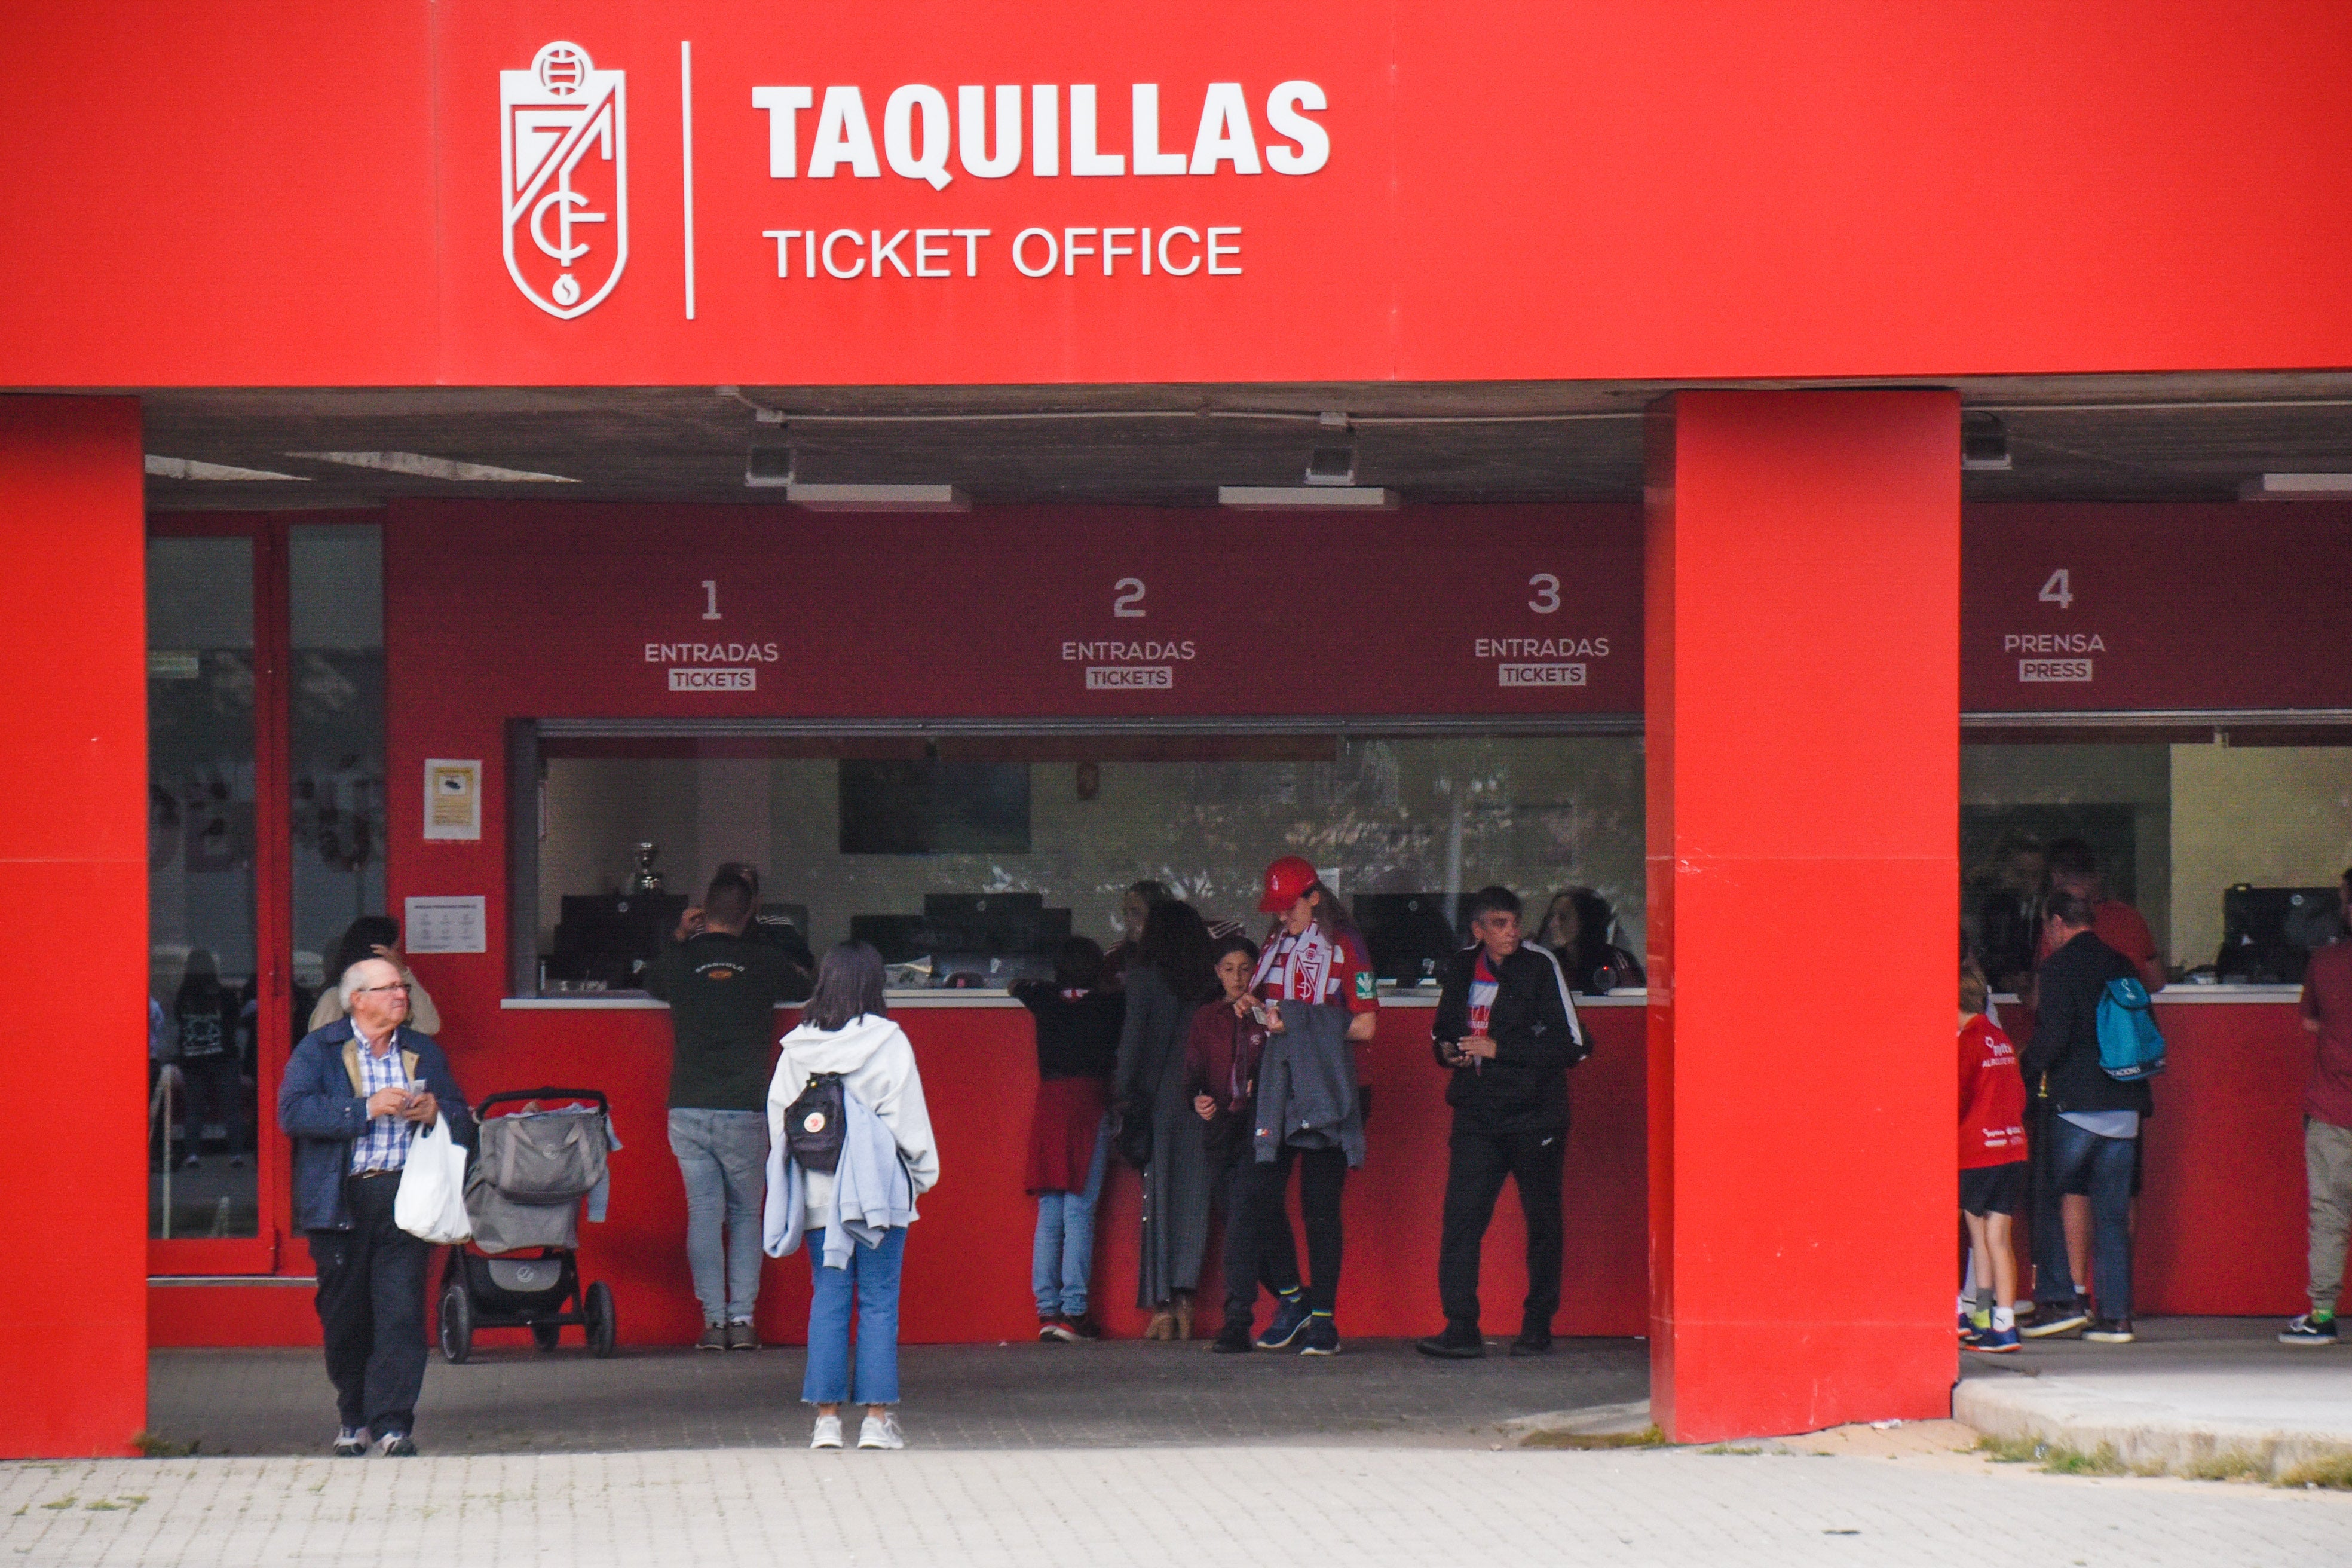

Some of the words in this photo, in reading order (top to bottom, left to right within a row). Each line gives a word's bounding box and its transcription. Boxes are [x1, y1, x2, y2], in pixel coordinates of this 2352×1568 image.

[751, 79, 1331, 191] TAQUILLAS
[762, 228, 991, 279] TICKET
[1012, 225, 1242, 278] OFFICE
[1113, 577, 1147, 618] 2
[1527, 572, 1561, 614] 3
[2038, 567, 2074, 610] 4
[701, 580, 722, 620] 1
[644, 642, 780, 663] ENTRADAS
[1061, 640, 1196, 661] ENTRADAS
[1474, 636, 1610, 658] ENTRADAS
[2004, 633, 2106, 654] PRENSA
[673, 671, 752, 688] TICKETS
[1091, 669, 1169, 686] TICKETS
[1502, 666, 1582, 683] TICKETS
[2023, 662, 2088, 678] PRESS
